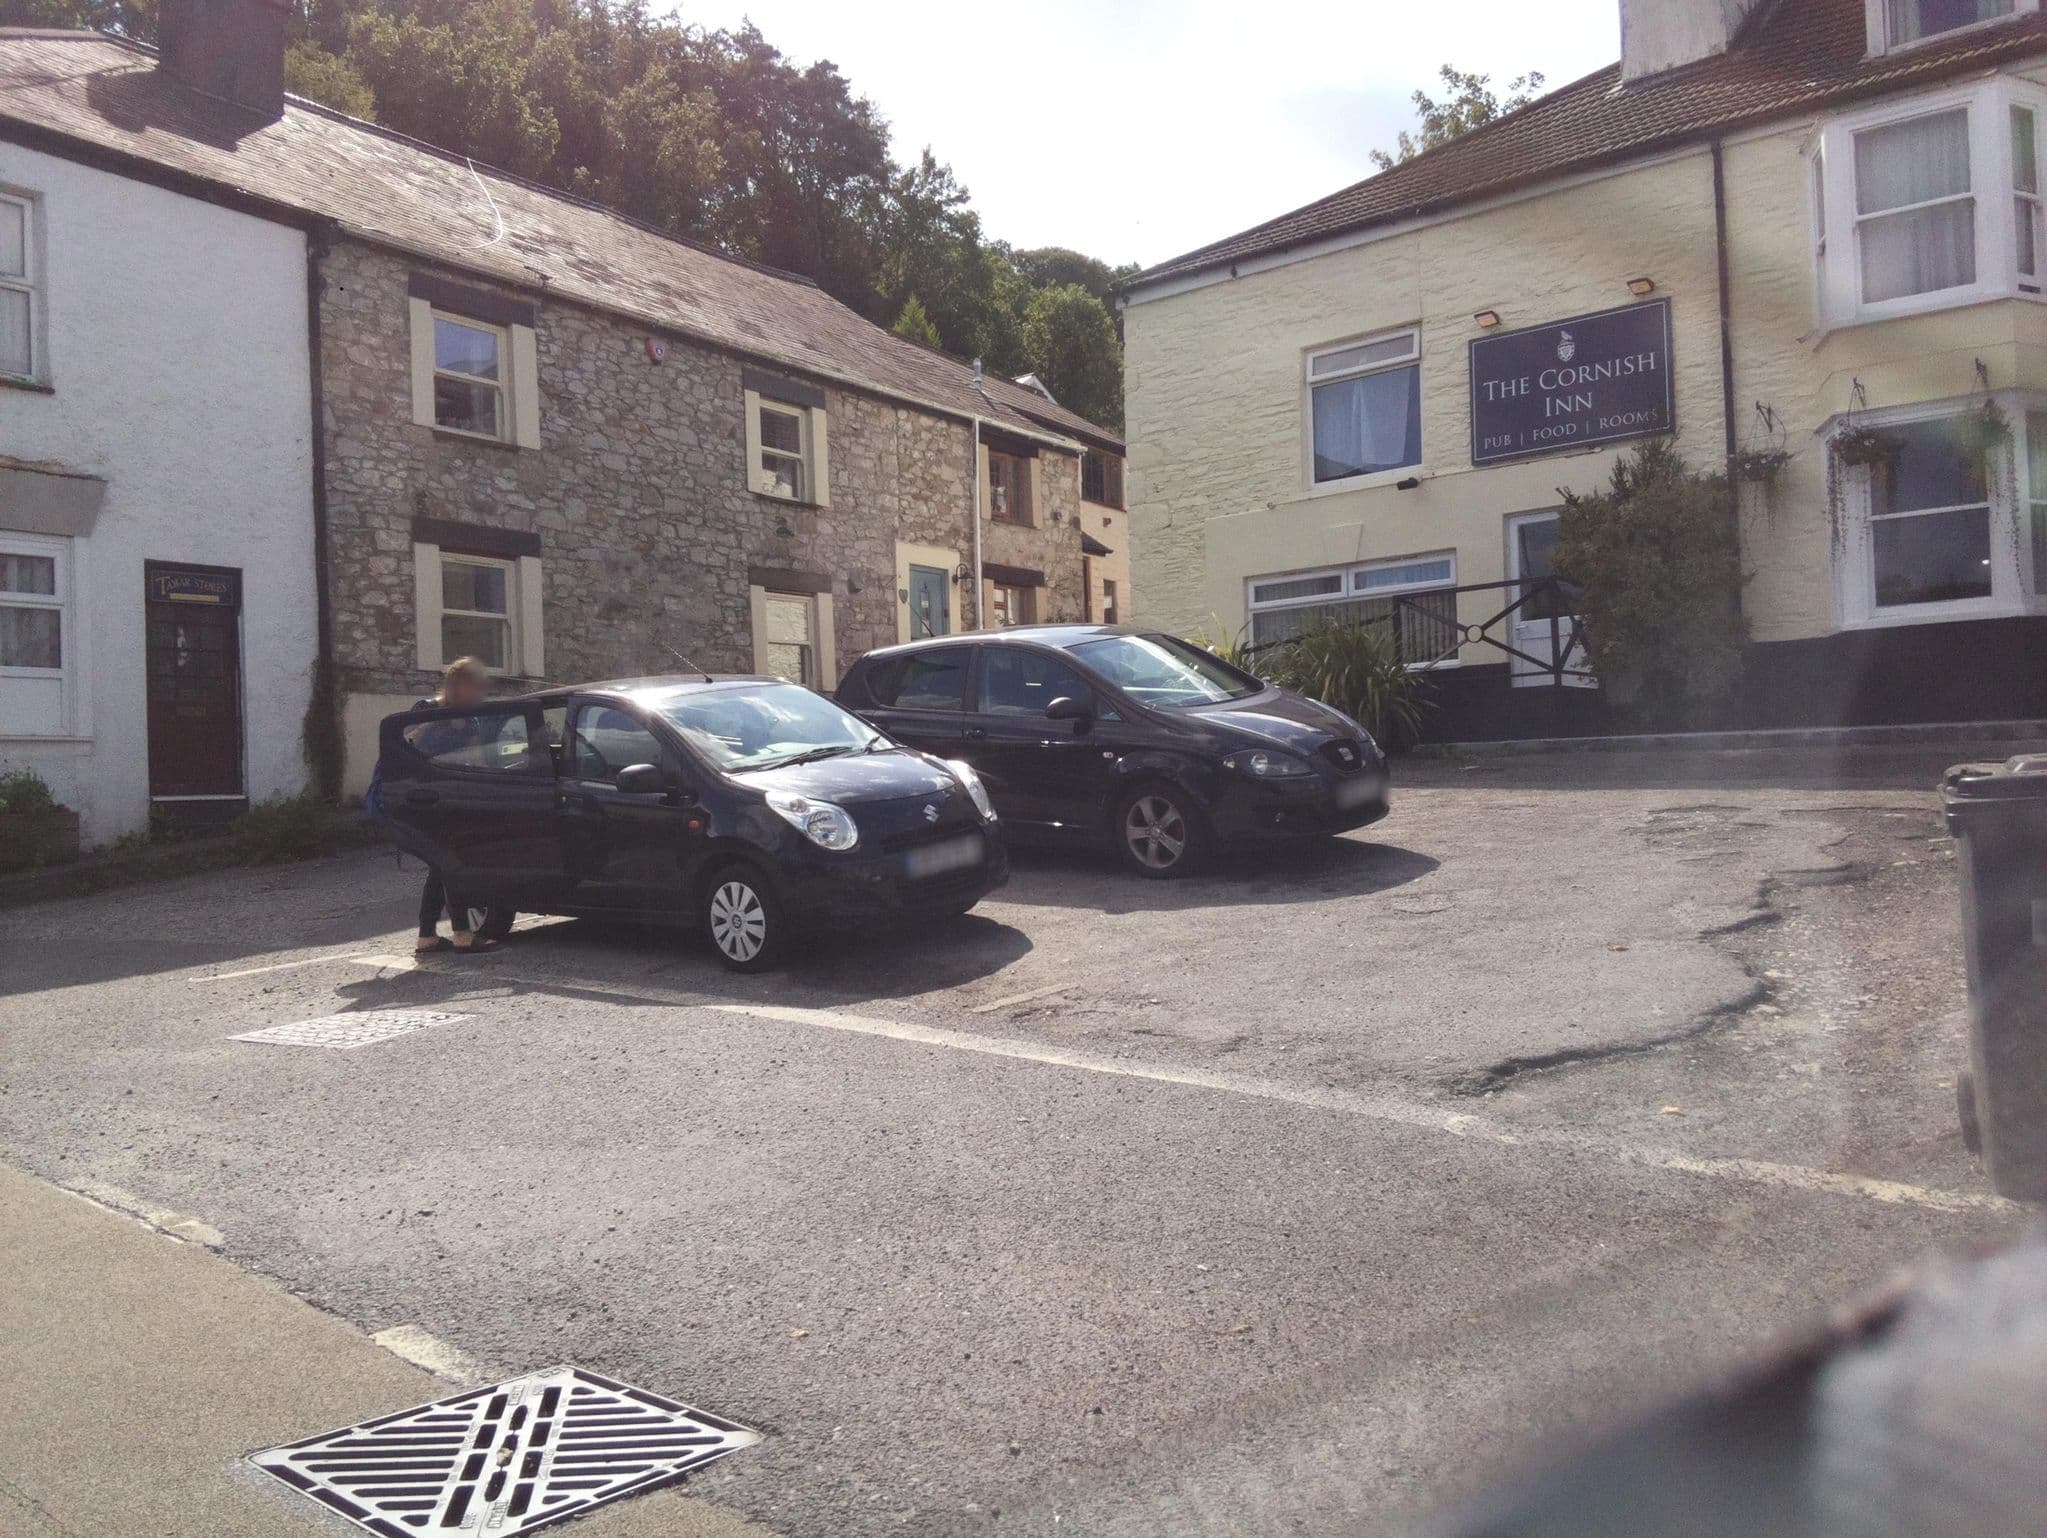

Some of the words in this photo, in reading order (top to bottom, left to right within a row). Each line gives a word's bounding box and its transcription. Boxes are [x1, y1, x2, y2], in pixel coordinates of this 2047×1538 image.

[1483, 376, 1530, 401] THE
[1539, 352, 1657, 391] CORNISH
[1544, 392, 1593, 417] INN
[1484, 434, 1512, 450] PUB
[1532, 423, 1577, 441] FOOD
